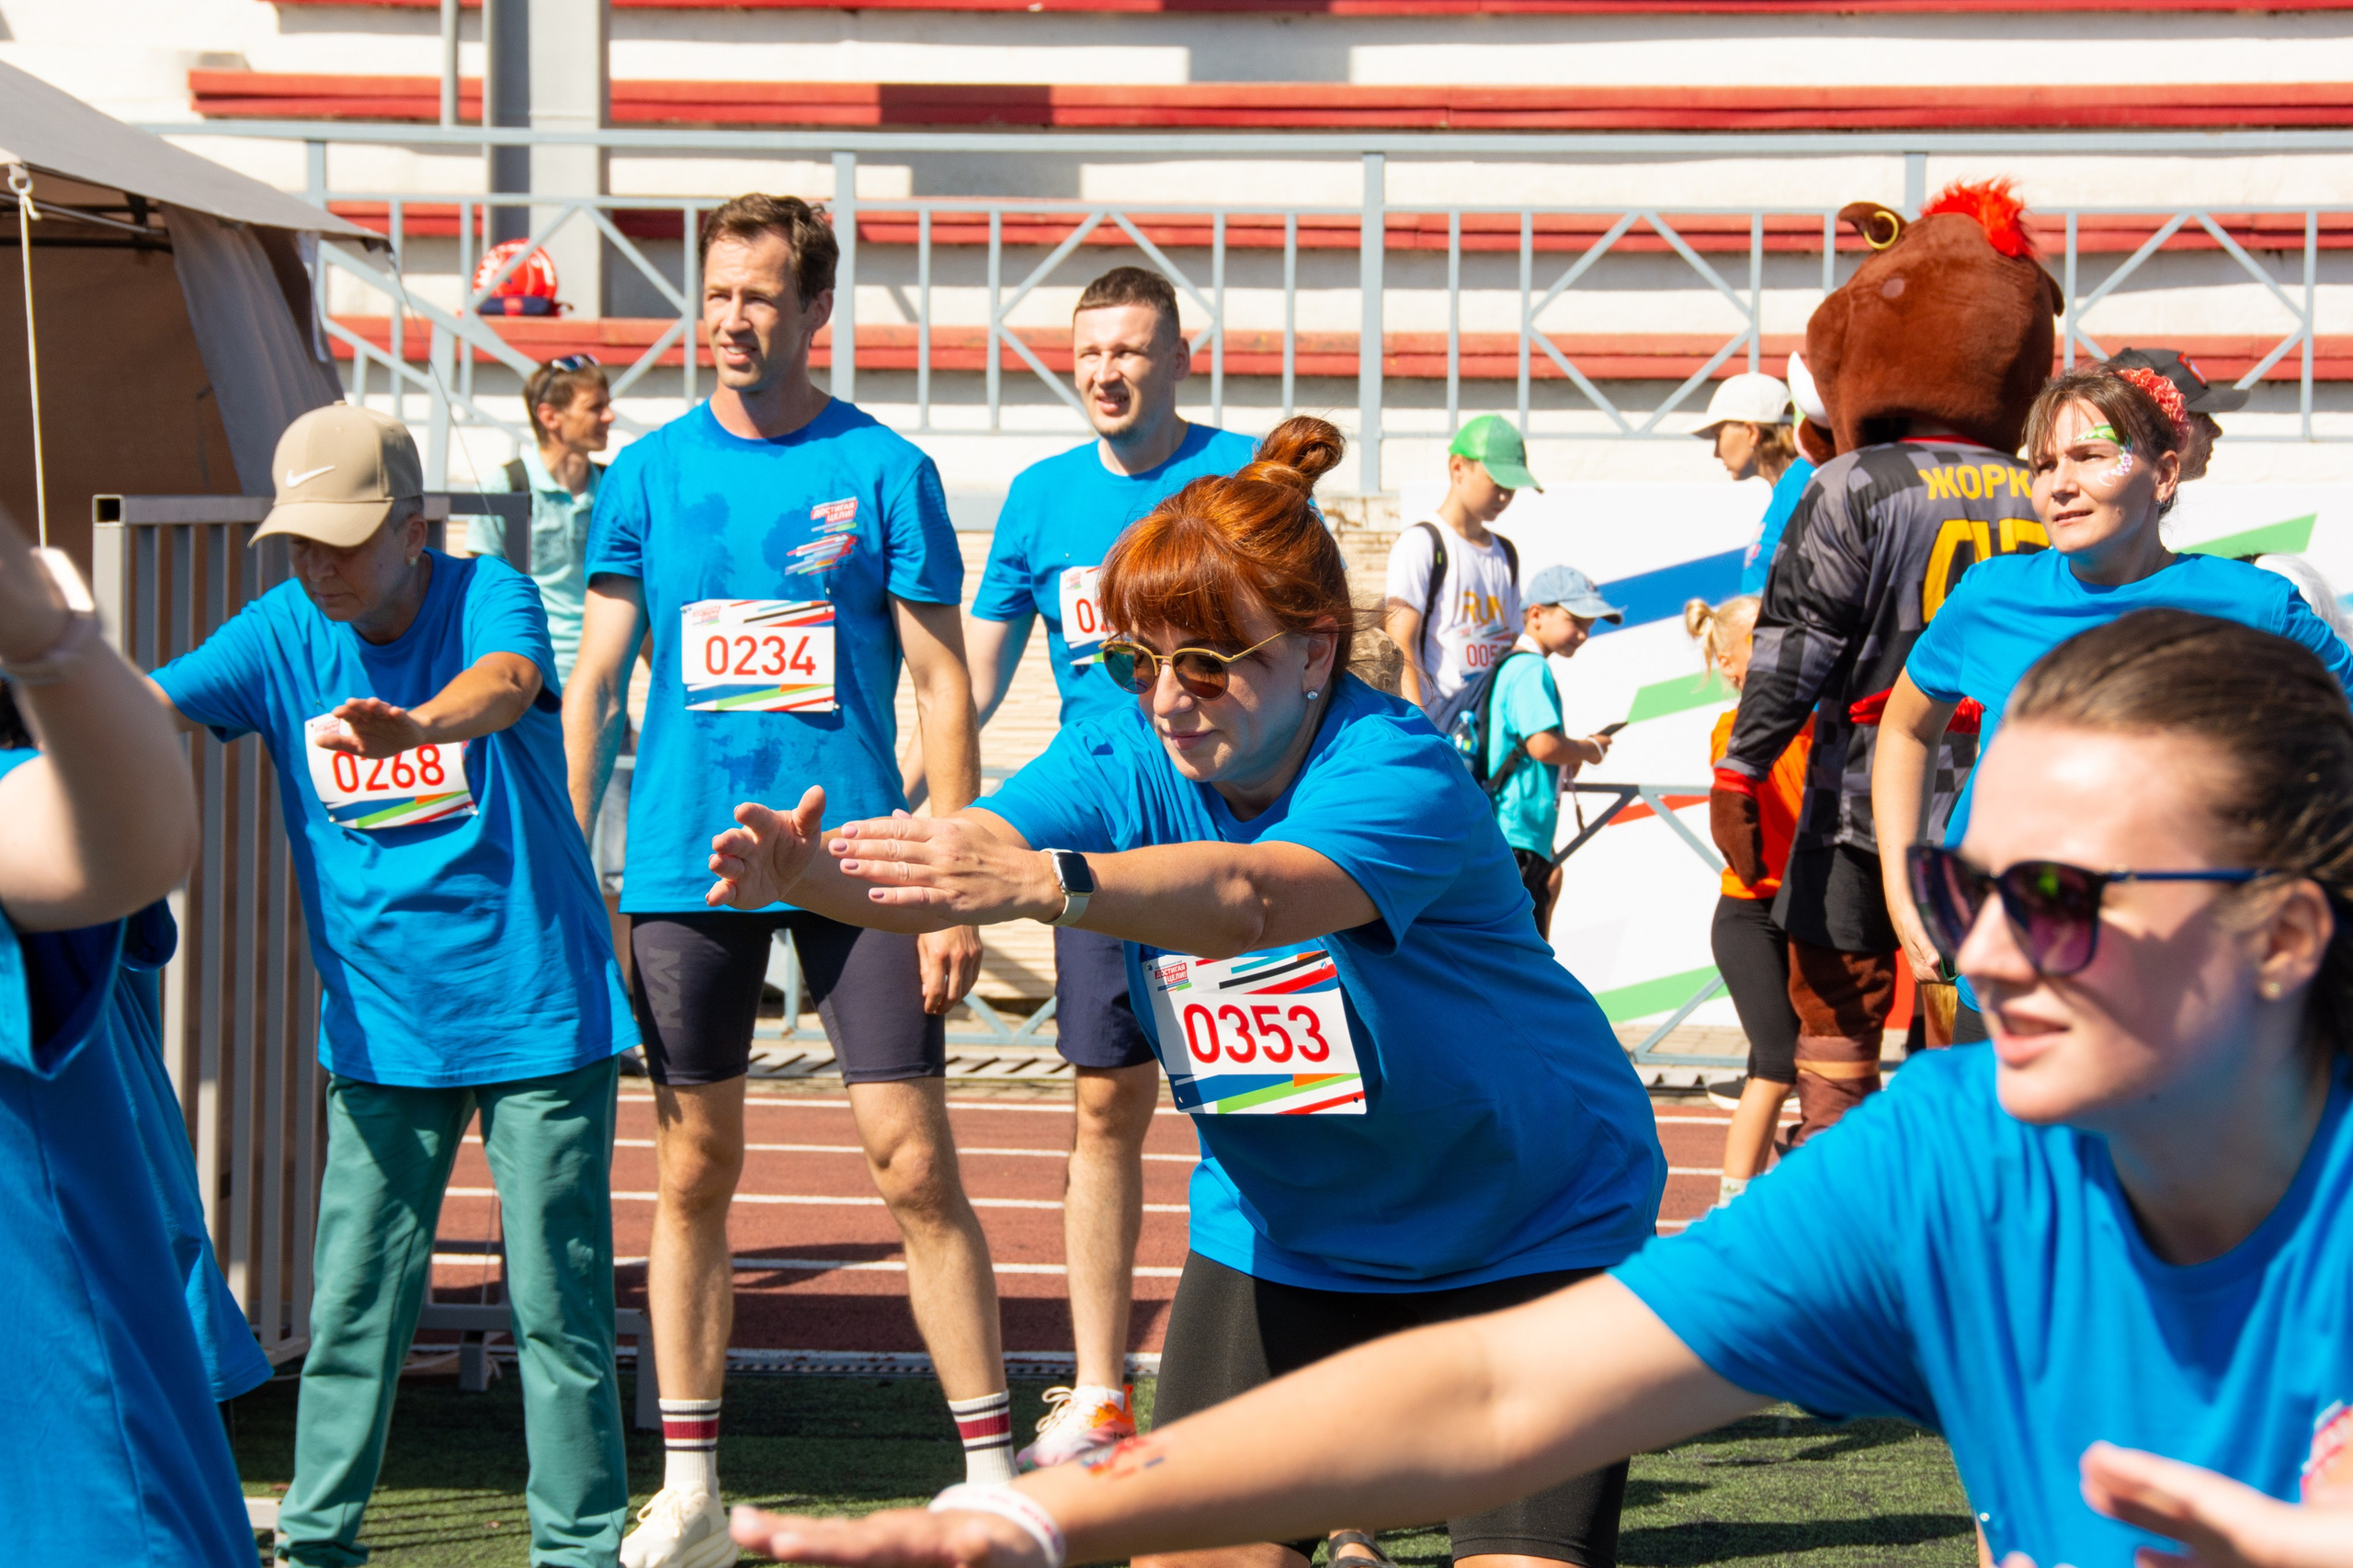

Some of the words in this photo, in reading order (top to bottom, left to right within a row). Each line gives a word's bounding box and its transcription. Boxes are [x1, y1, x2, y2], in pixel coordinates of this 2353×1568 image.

[1918, 464, 2032, 500] ЖОРК
[813, 502, 855, 519] ДОСТИГАЯ
[827, 509, 854, 522] ЦЕЛИ!
[1461, 591, 1506, 629] RUN
[705, 635, 816, 676] 0234
[1466, 643, 1498, 667] 005
[332, 744, 445, 793] 0268
[1156, 963, 1186, 979] ДОСТИГАЯ
[1166, 971, 1188, 983] ЦЕЛИ!
[1183, 1003, 1330, 1063] 0353
